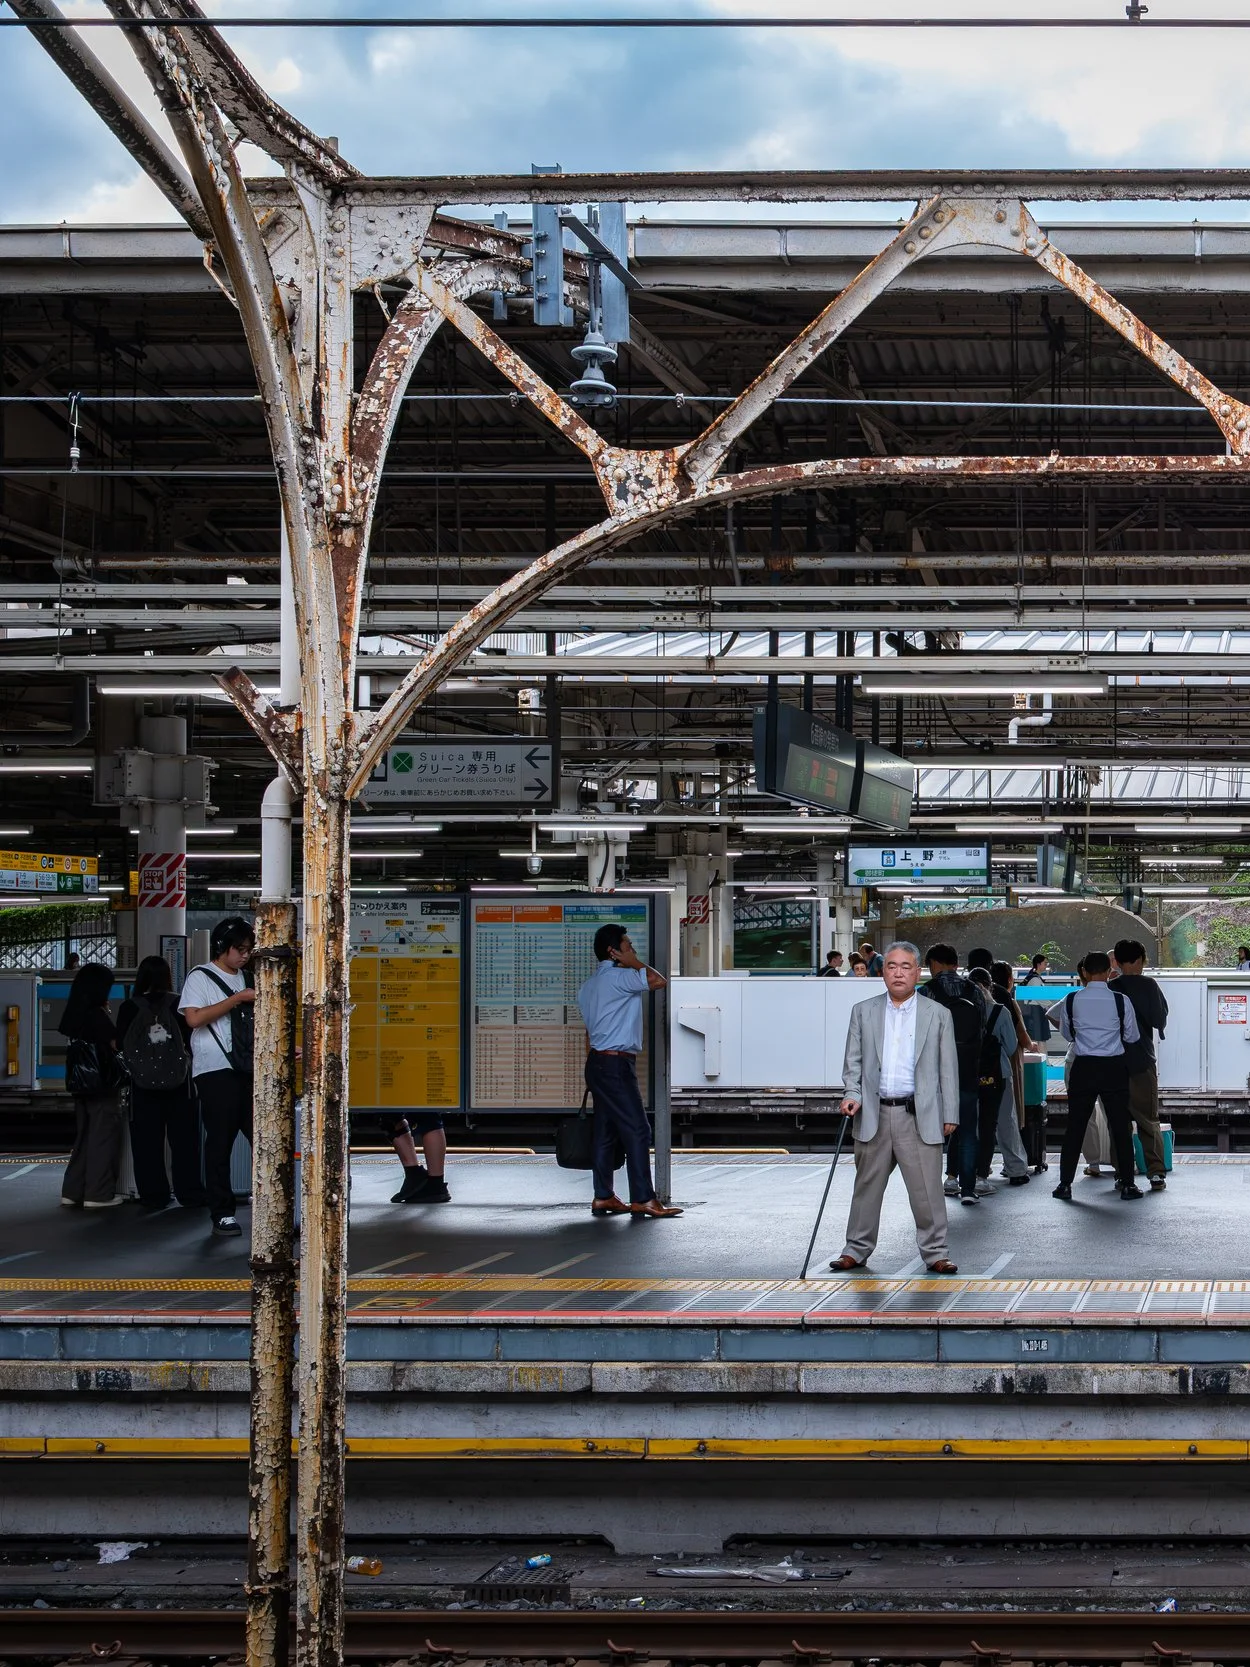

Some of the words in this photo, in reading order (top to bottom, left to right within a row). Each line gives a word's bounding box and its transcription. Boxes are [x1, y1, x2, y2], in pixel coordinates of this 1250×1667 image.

[419, 752, 465, 761] Suica
[471, 750, 496, 762] 専用
[417, 763, 516, 775] グリーン券うりば
[498, 776, 517, 784] Only)
[864, 869, 885, 877] 御徒町
